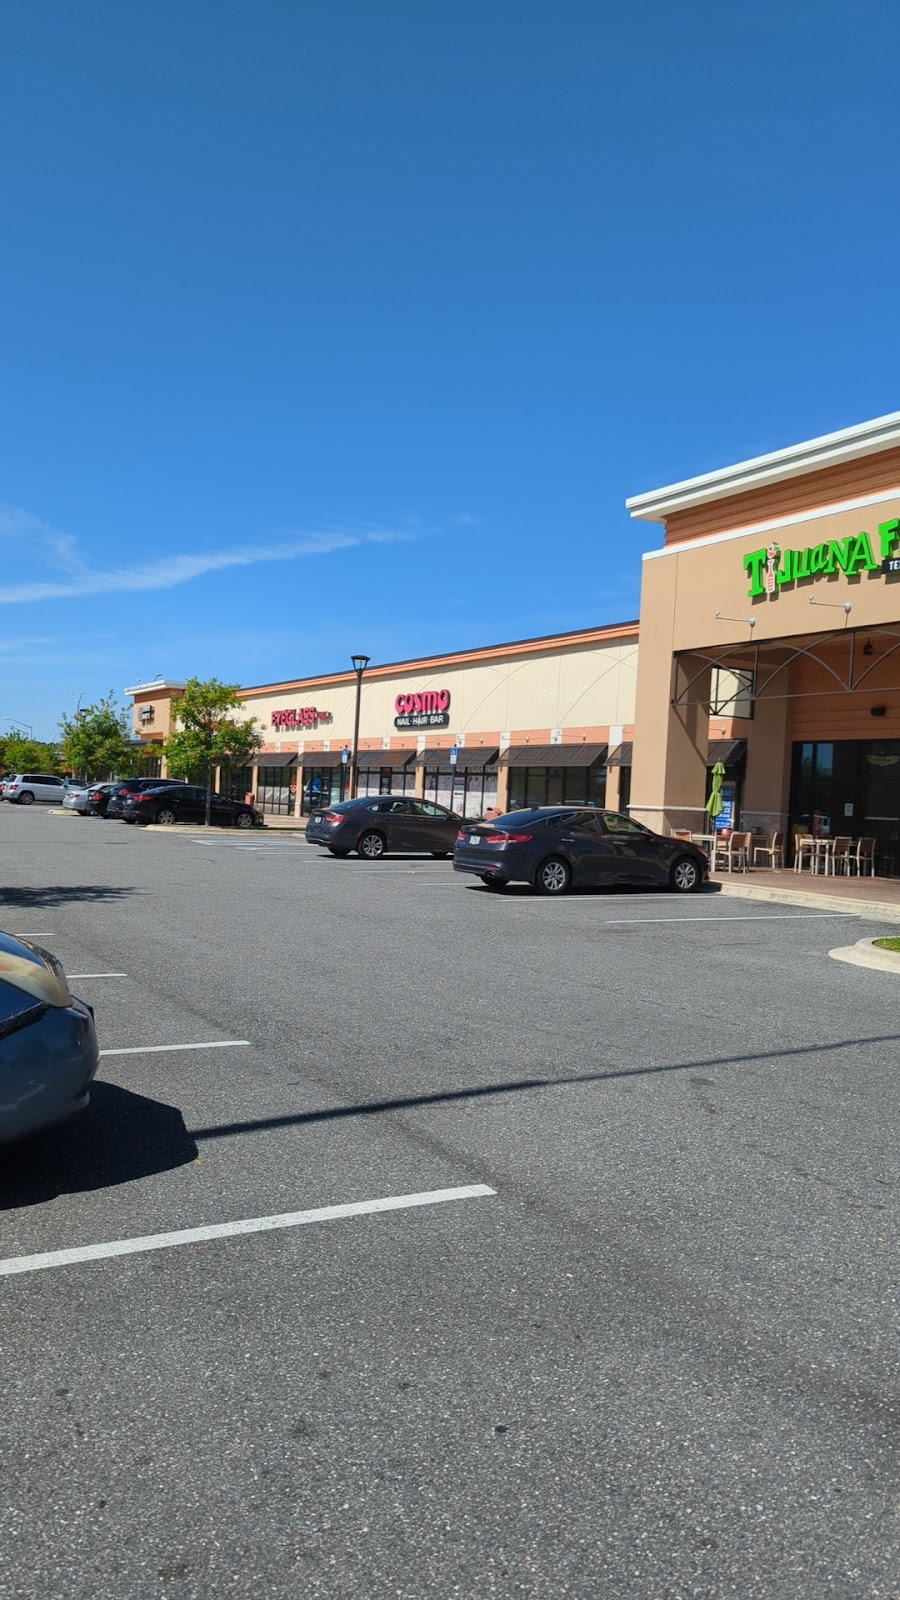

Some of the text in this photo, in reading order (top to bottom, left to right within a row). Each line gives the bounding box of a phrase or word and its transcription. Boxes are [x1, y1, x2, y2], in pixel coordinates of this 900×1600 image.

[397, 714, 444, 726] NAIL HAIR BAR
